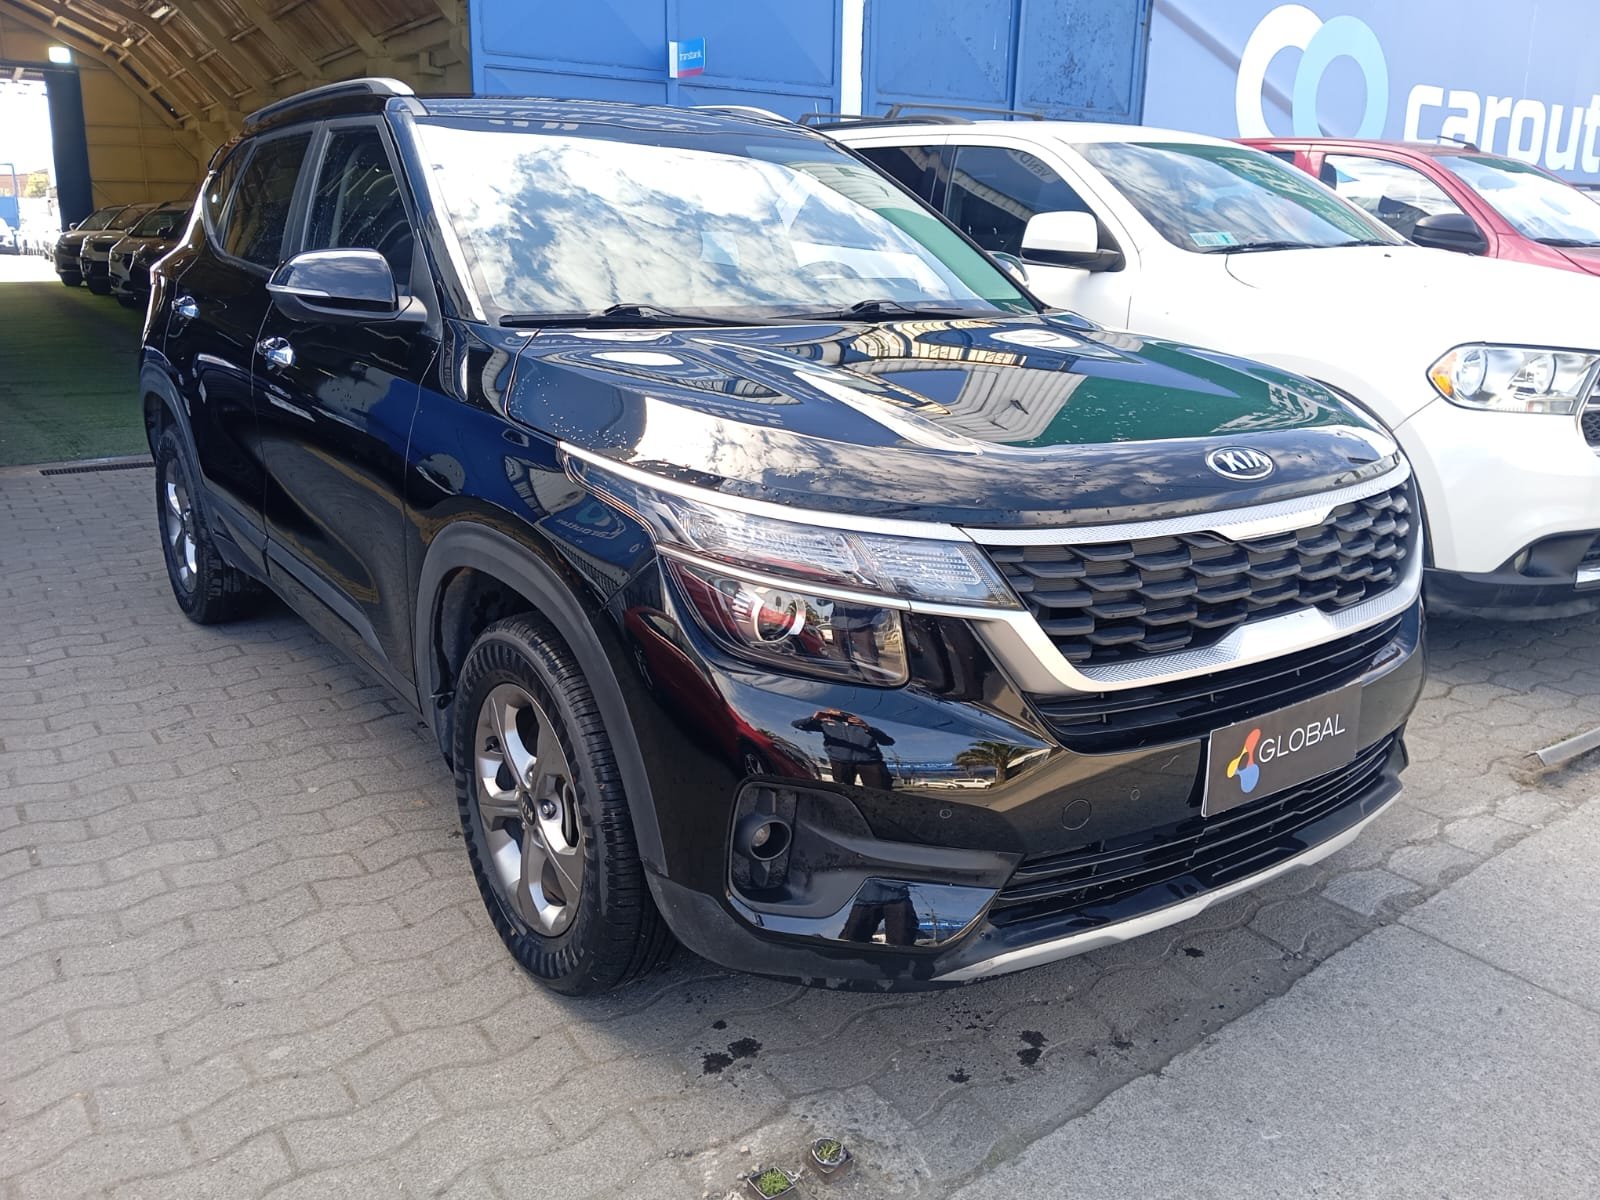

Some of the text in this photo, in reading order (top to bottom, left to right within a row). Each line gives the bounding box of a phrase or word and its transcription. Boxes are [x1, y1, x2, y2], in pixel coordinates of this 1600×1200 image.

[1403, 84, 1600, 173] carout
[1216, 449, 1270, 472] KIA
[1258, 713, 1346, 763] GLOBAL
